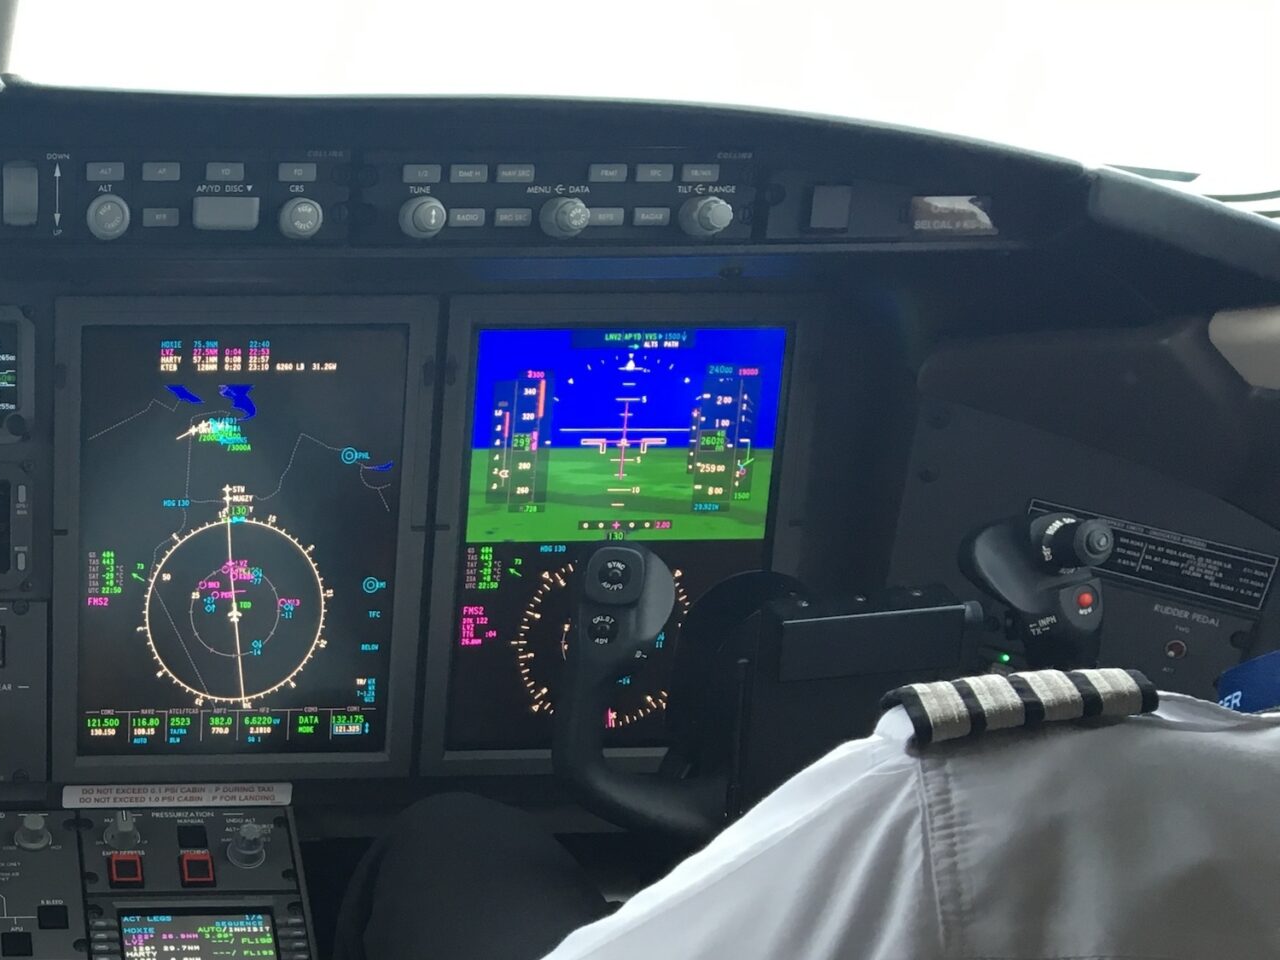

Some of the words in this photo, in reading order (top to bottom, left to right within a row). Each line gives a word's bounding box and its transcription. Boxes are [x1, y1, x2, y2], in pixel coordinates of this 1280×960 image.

[98, 184, 112, 192] ALT
[196, 185, 221, 193] AP/YD
[224, 185, 243, 193] DISC
[289, 184, 304, 193] CRS
[410, 185, 431, 194] TUNE
[526, 185, 551, 193] MENU
[569, 185, 590, 193] DATA
[677, 185, 691, 193] TILT
[708, 186, 736, 194] RANGE
[606, 559, 626, 571] SYNC
[87, 597, 109, 606] FMS2
[463, 606, 484, 615] FMS2
[1152, 602, 1190, 621] RUDDER
[1190, 610, 1220, 628] PEDAL
[87, 717, 120, 727] 121.500
[131, 717, 160, 727] 116.80
[170, 717, 190, 726] 2523
[209, 717, 233, 726] 382.0
[298, 715, 319, 725] DATA
[331, 714, 365, 724] 132.175
[81, 787, 95, 795] DO
[97, 787, 114, 795] NOT
[115, 786, 148, 795] EXCEED
[164, 786, 178, 795] PSI
[179, 786, 206, 794] CABIN
[214, 785, 220, 793] P
[222, 785, 254, 793] DURING
[257, 785, 274, 793] TAXI
[79, 796, 92, 804] DO
[94, 796, 110, 804] NOT
[112, 796, 145, 804] EXCEED
[148, 796, 160, 804] 1.0
[161, 795, 175, 804] PSI
[176, 795, 203, 803] CABIN
[221, 795, 237, 803] FOR
[238, 794, 275, 803] LANDING
